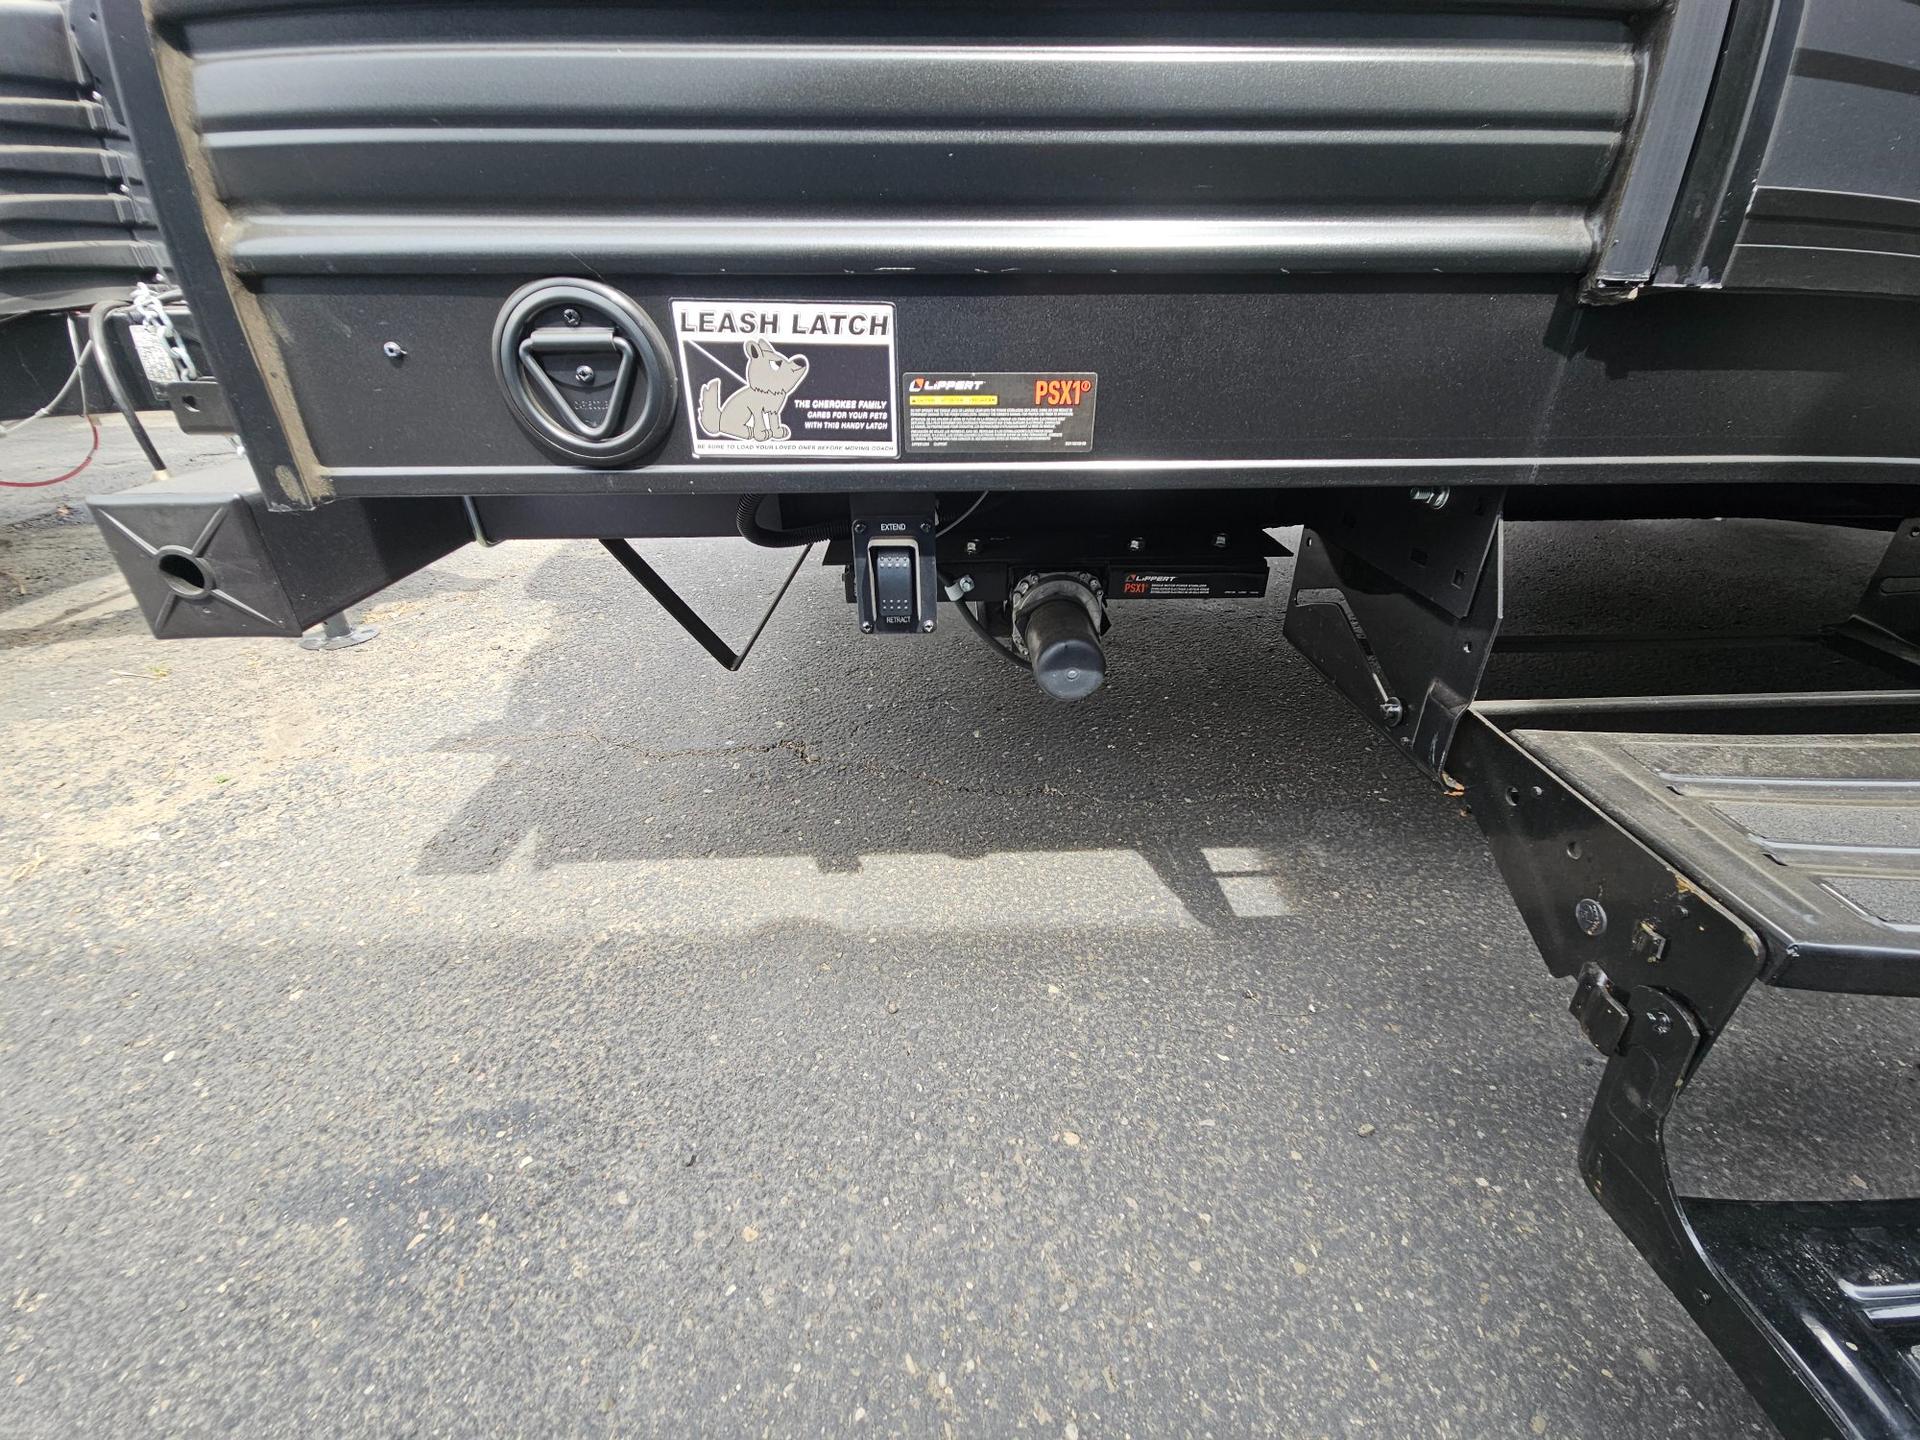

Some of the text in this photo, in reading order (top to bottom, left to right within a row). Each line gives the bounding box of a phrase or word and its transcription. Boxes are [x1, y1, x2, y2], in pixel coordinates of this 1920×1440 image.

[680, 311, 889, 336] LEASH LATCH
[794, 399, 888, 409] THE CHEROKEE FAMILY
[807, 411, 888, 420] CARES FOR YOUR PETS
[804, 421, 888, 430] WITH THIS HANDY LATCH
[880, 523, 906, 531] EXTEND
[886, 615, 911, 624] RETRACT
